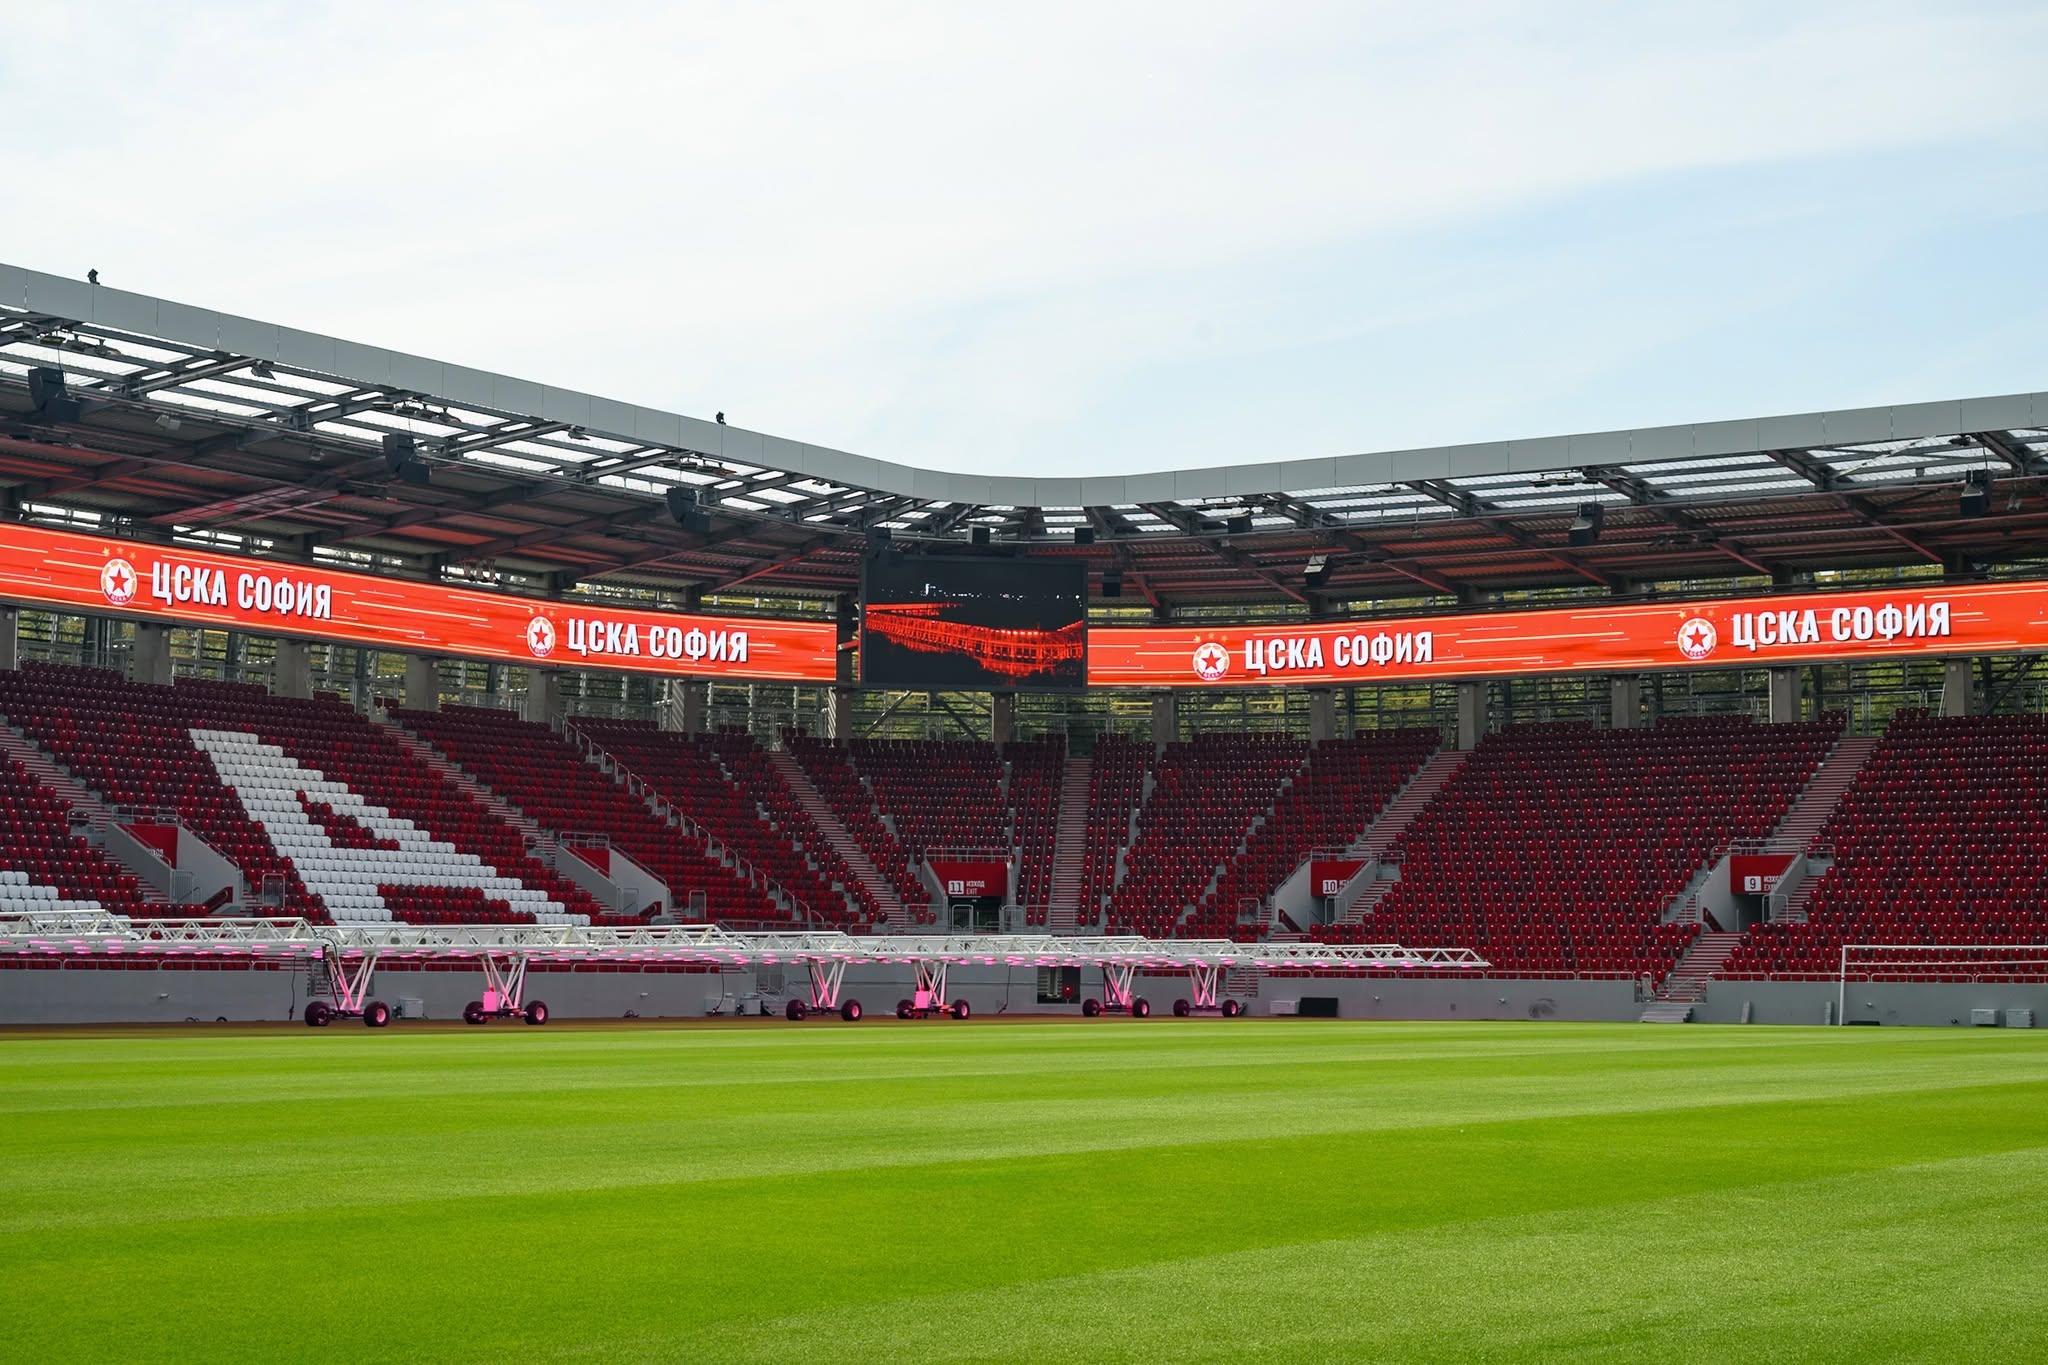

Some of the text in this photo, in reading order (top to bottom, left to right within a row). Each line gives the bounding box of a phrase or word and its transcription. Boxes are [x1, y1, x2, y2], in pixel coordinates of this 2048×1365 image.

[151, 561, 332, 619] ЦСКА СОФИЯ
[567, 618, 748, 662] ЦСКА СОФИЯ
[1733, 602, 1950, 652] ЦСКА СОФИЯ
[1244, 631, 1433, 675] ЦСКА СОФИЯ
[950, 882, 963, 893] 11
[1324, 881, 1336, 892] 10
[1750, 878, 1756, 889] 9
